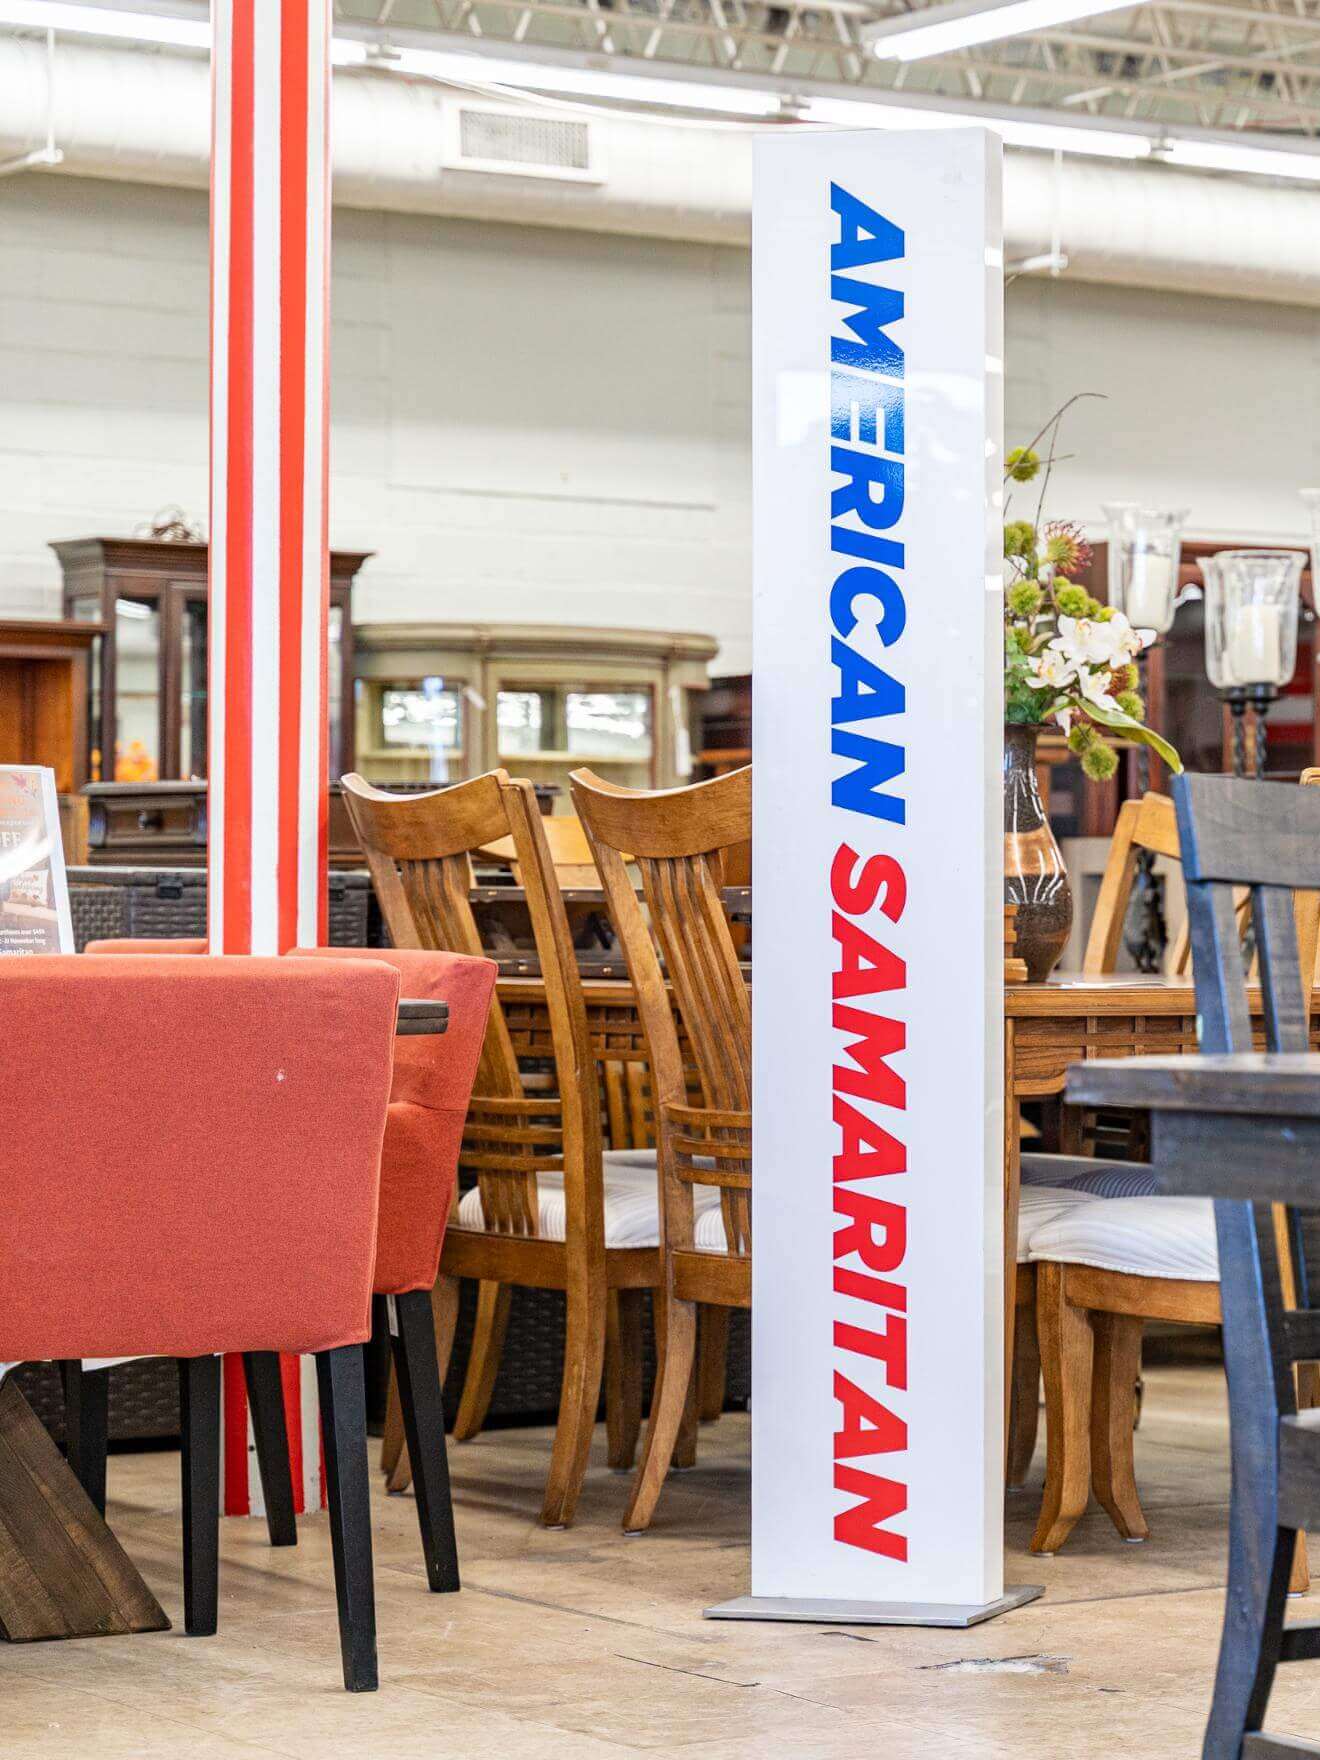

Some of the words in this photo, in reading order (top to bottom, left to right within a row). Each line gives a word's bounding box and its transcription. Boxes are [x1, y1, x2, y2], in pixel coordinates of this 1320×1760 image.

[829, 181, 906, 827] AMERICAN
[0, 831, 21, 848] FF
[830, 842, 908, 1561] SAMARITAN
